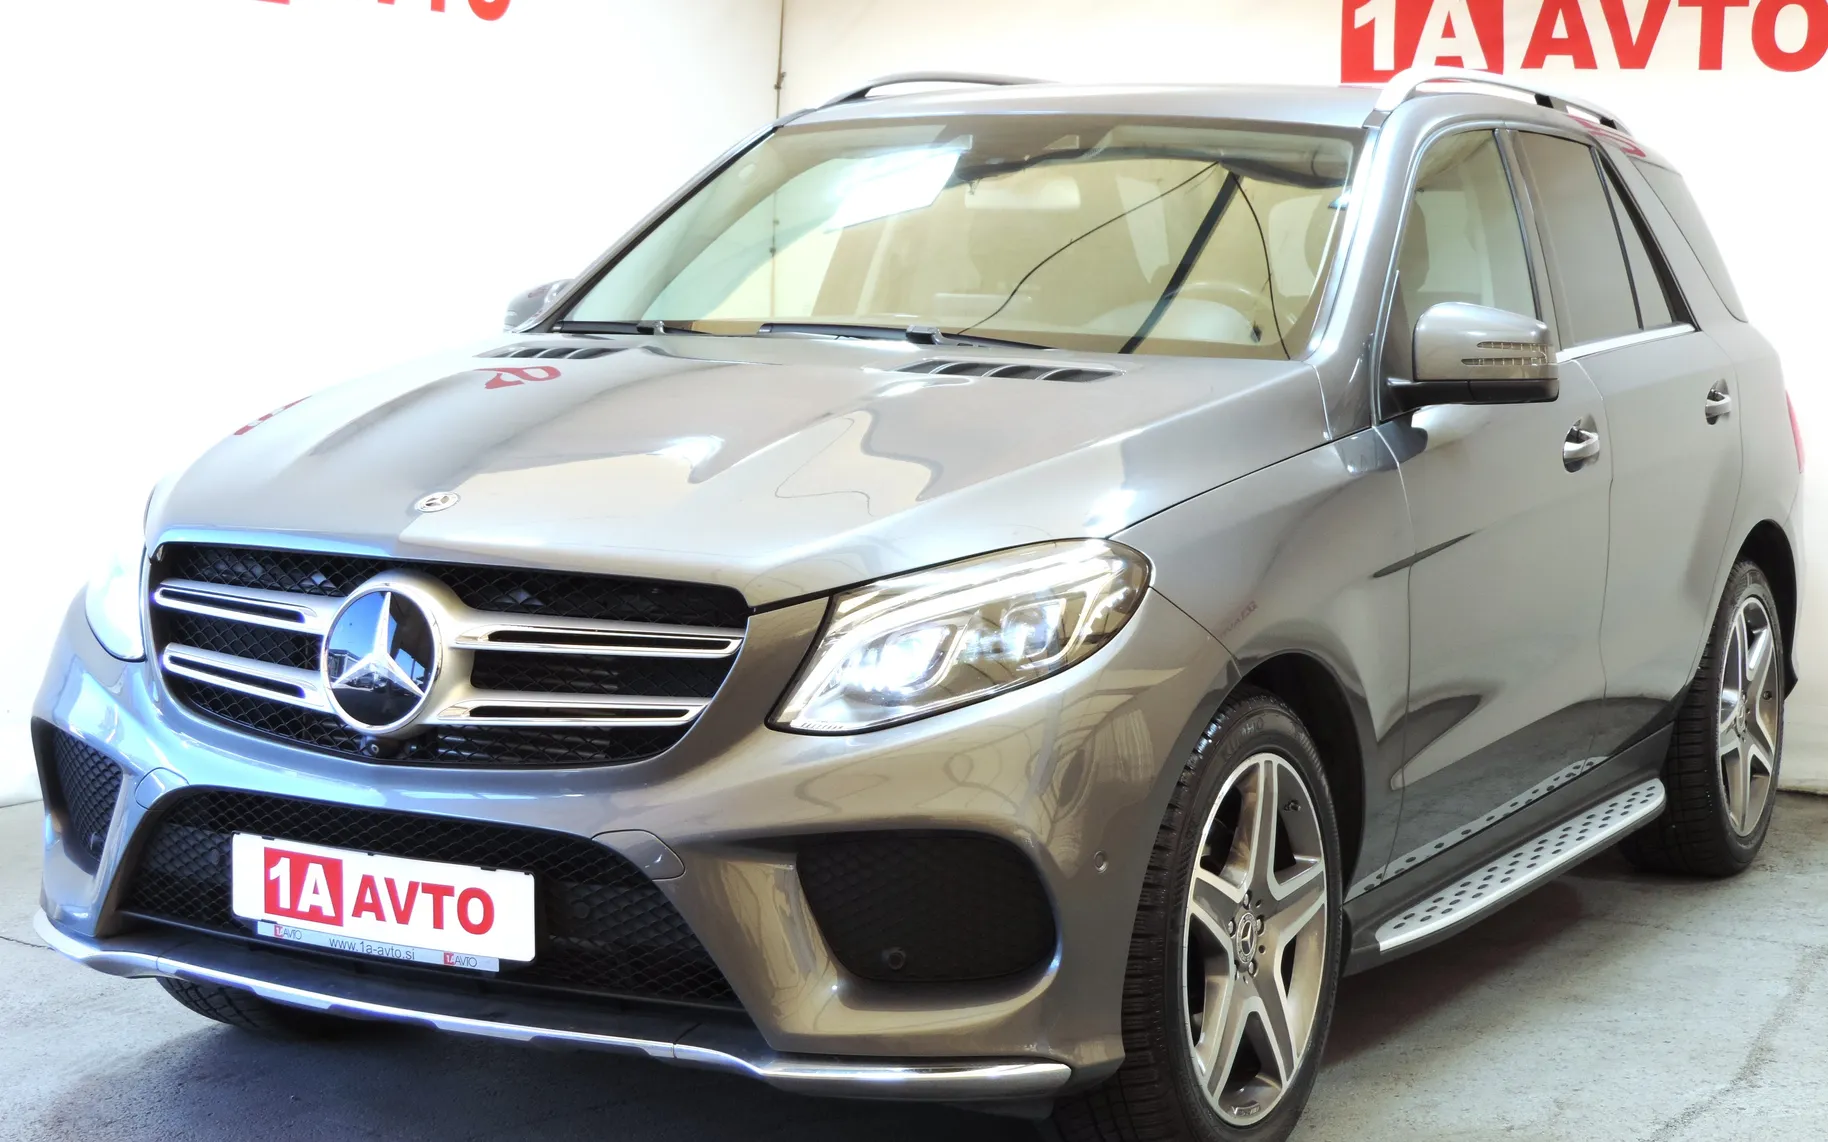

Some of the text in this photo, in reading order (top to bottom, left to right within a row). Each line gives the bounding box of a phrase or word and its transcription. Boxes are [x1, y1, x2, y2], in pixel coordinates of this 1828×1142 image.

[1353, 0, 1828, 72] 1A AVTO
[268, 856, 495, 936] 1A AVTO
[328, 938, 415, 960] www.1a-avto.si
[455, 955, 478, 968] AVTO
